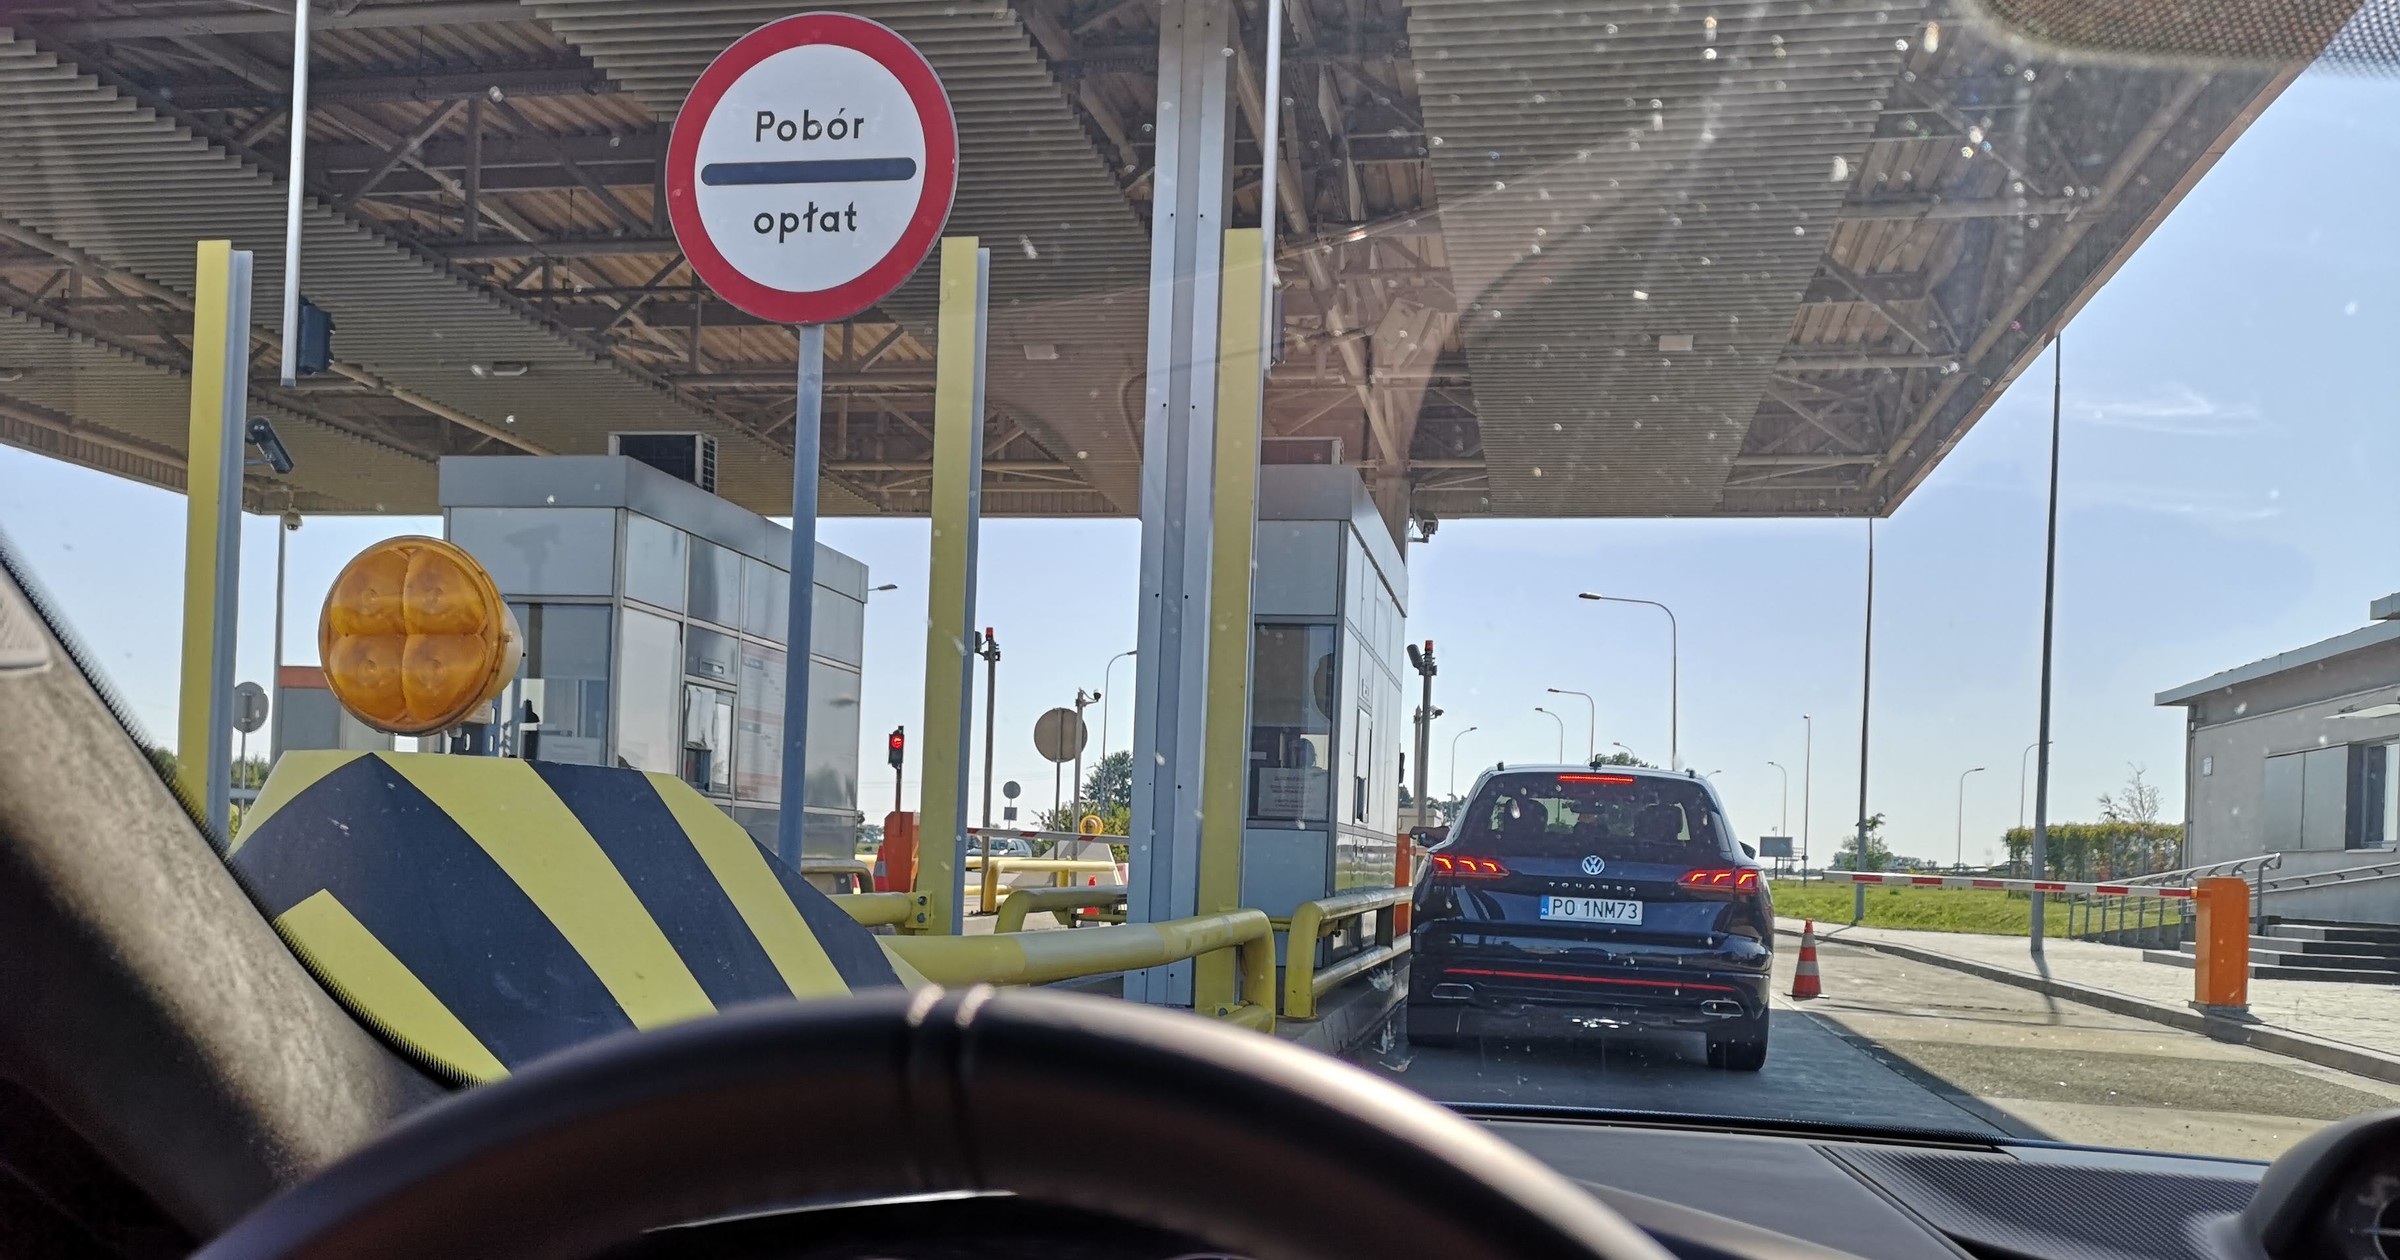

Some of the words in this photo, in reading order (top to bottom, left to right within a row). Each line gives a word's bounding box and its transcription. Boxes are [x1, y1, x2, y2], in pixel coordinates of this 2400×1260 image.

[755, 108, 864, 142] Pobór
[753, 201, 857, 243] opłat
[1548, 882, 1636, 893] TOUAREG
[1552, 898, 1575, 916] PO
[1583, 900, 1638, 919] 1NM73
